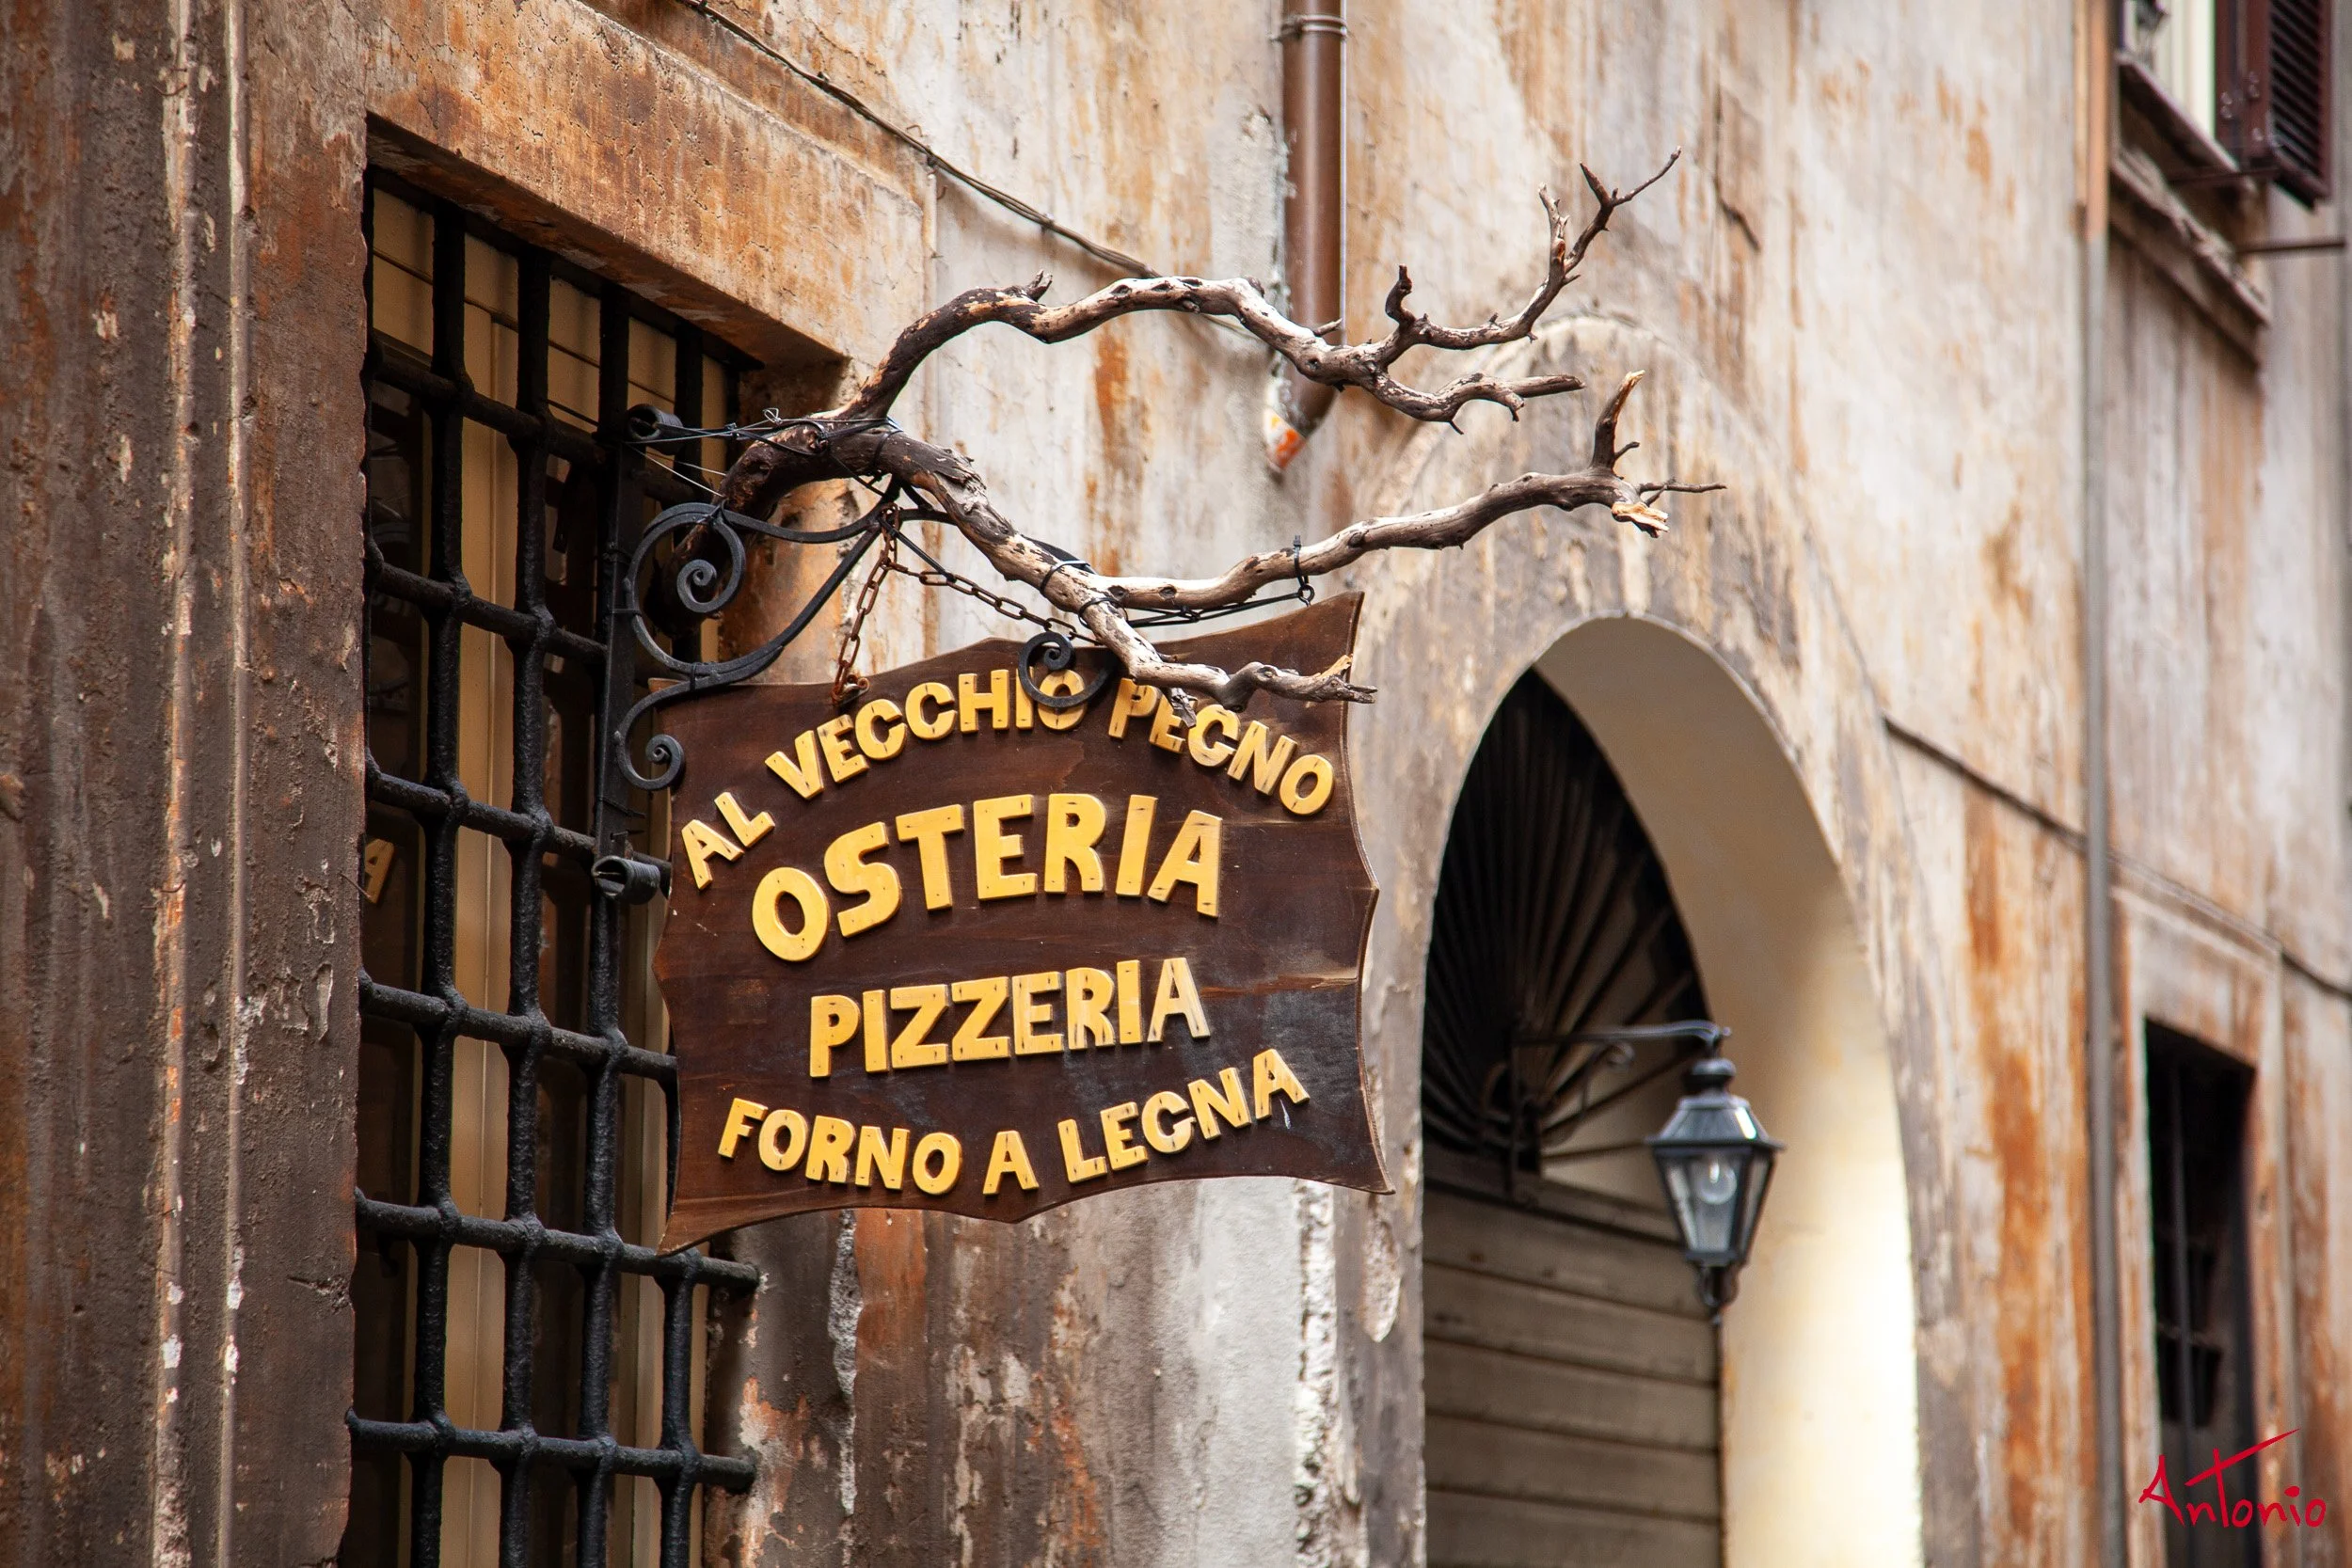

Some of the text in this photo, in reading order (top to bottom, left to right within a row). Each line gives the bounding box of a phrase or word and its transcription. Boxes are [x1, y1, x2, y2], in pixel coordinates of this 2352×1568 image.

[681, 669, 1336, 890] AL VECCHIO PEGNO
[753, 793, 1223, 961] OSTERIA
[810, 958, 1210, 1078] PIZZERIA
[718, 1049, 1310, 1196] FORNO A LEGNA
